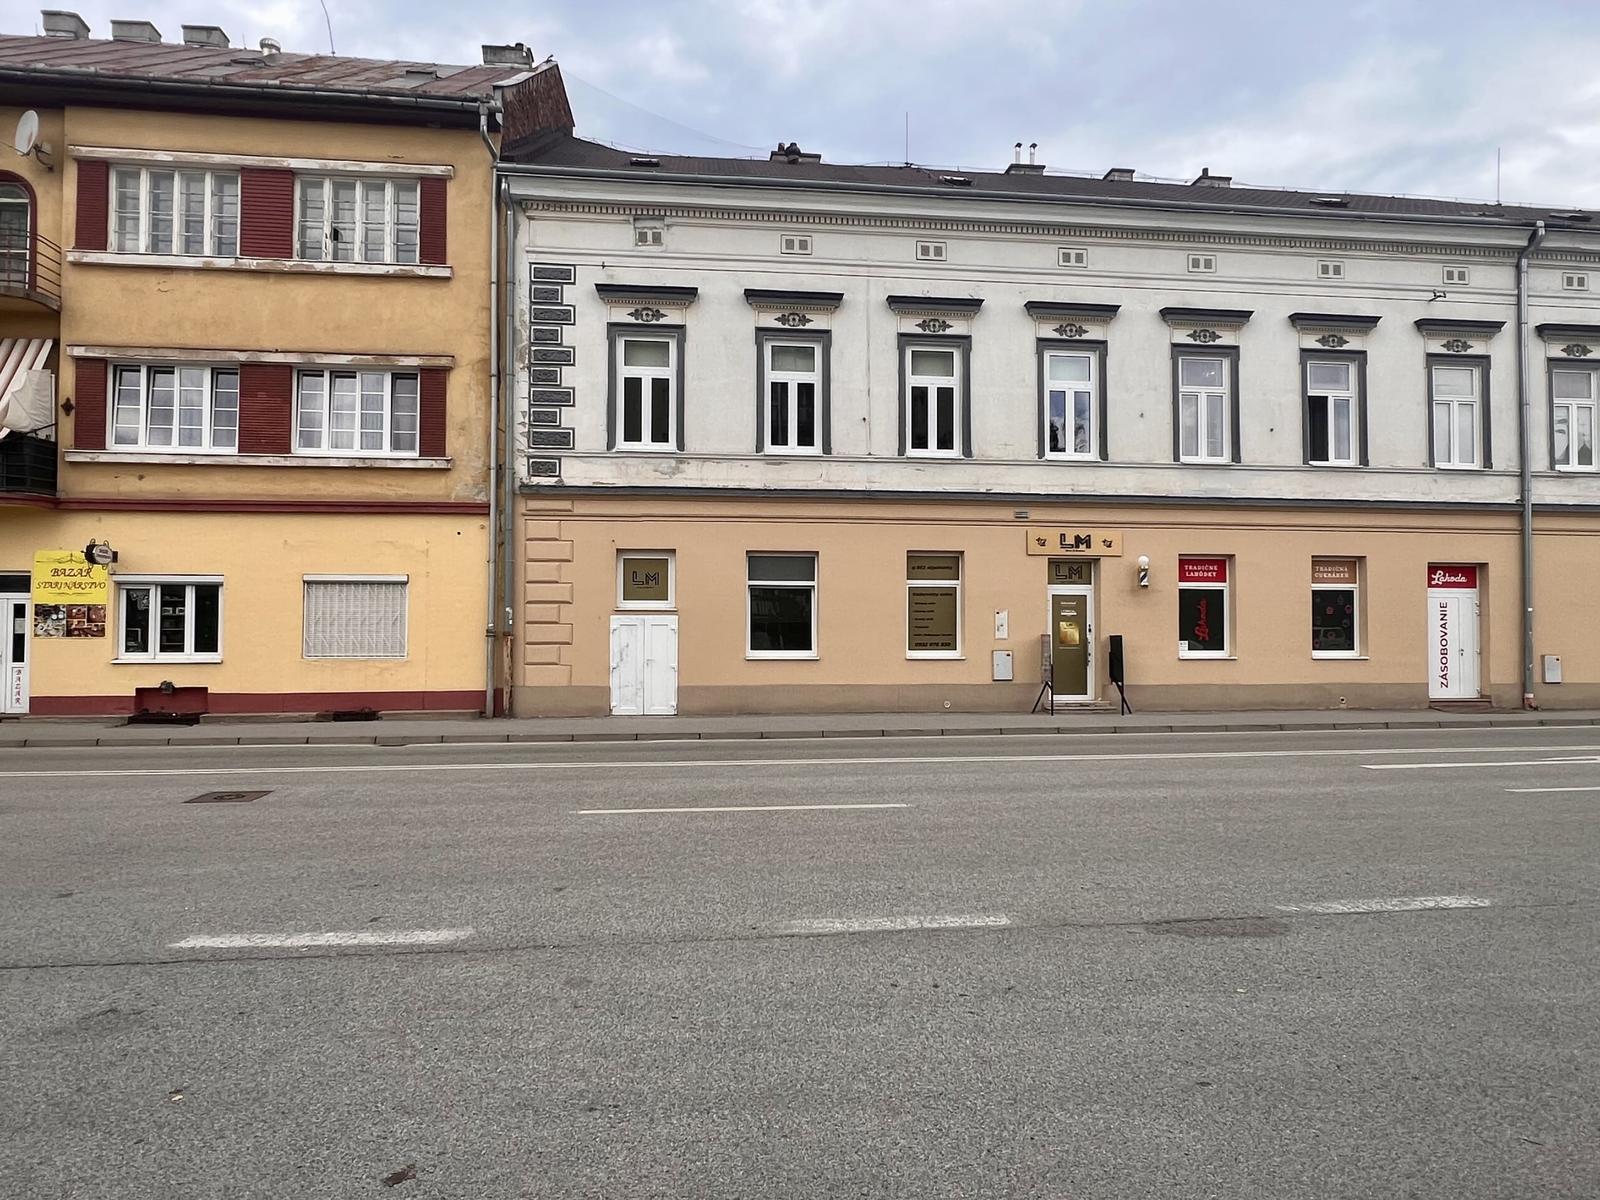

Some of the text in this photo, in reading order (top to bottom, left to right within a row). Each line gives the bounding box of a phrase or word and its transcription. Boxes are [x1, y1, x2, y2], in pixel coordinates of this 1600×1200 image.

[1060, 533, 1091, 549] LM
[632, 571, 659, 585] LM
[1055, 564, 1082, 580] LM
[1439, 602, 1449, 689] ZÁSOBOVANIE
